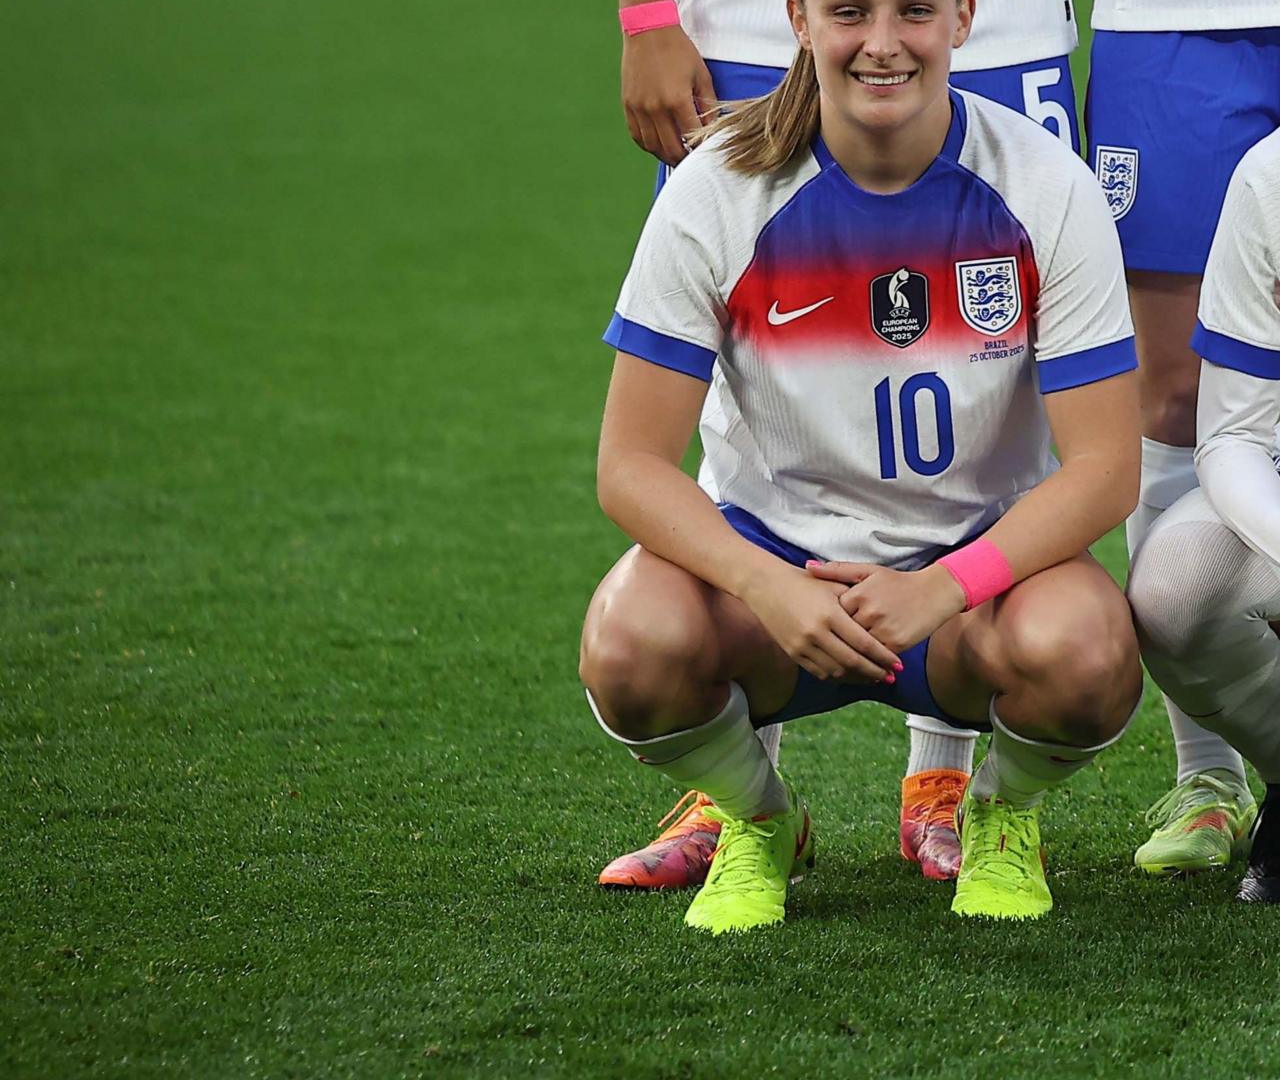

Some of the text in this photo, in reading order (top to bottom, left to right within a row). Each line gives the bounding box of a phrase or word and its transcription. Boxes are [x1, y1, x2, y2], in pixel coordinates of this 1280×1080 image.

[1021, 68, 1073, 151] 5
[890, 308, 910, 318] UEFA
[882, 318, 918, 326] EUROPEAN
[882, 324, 920, 333] CHAMPIONS
[984, 340, 1008, 350] BRAZIL
[969, 344, 1025, 362] 25 OCTOBER 2025
[875, 371, 955, 479] 10
